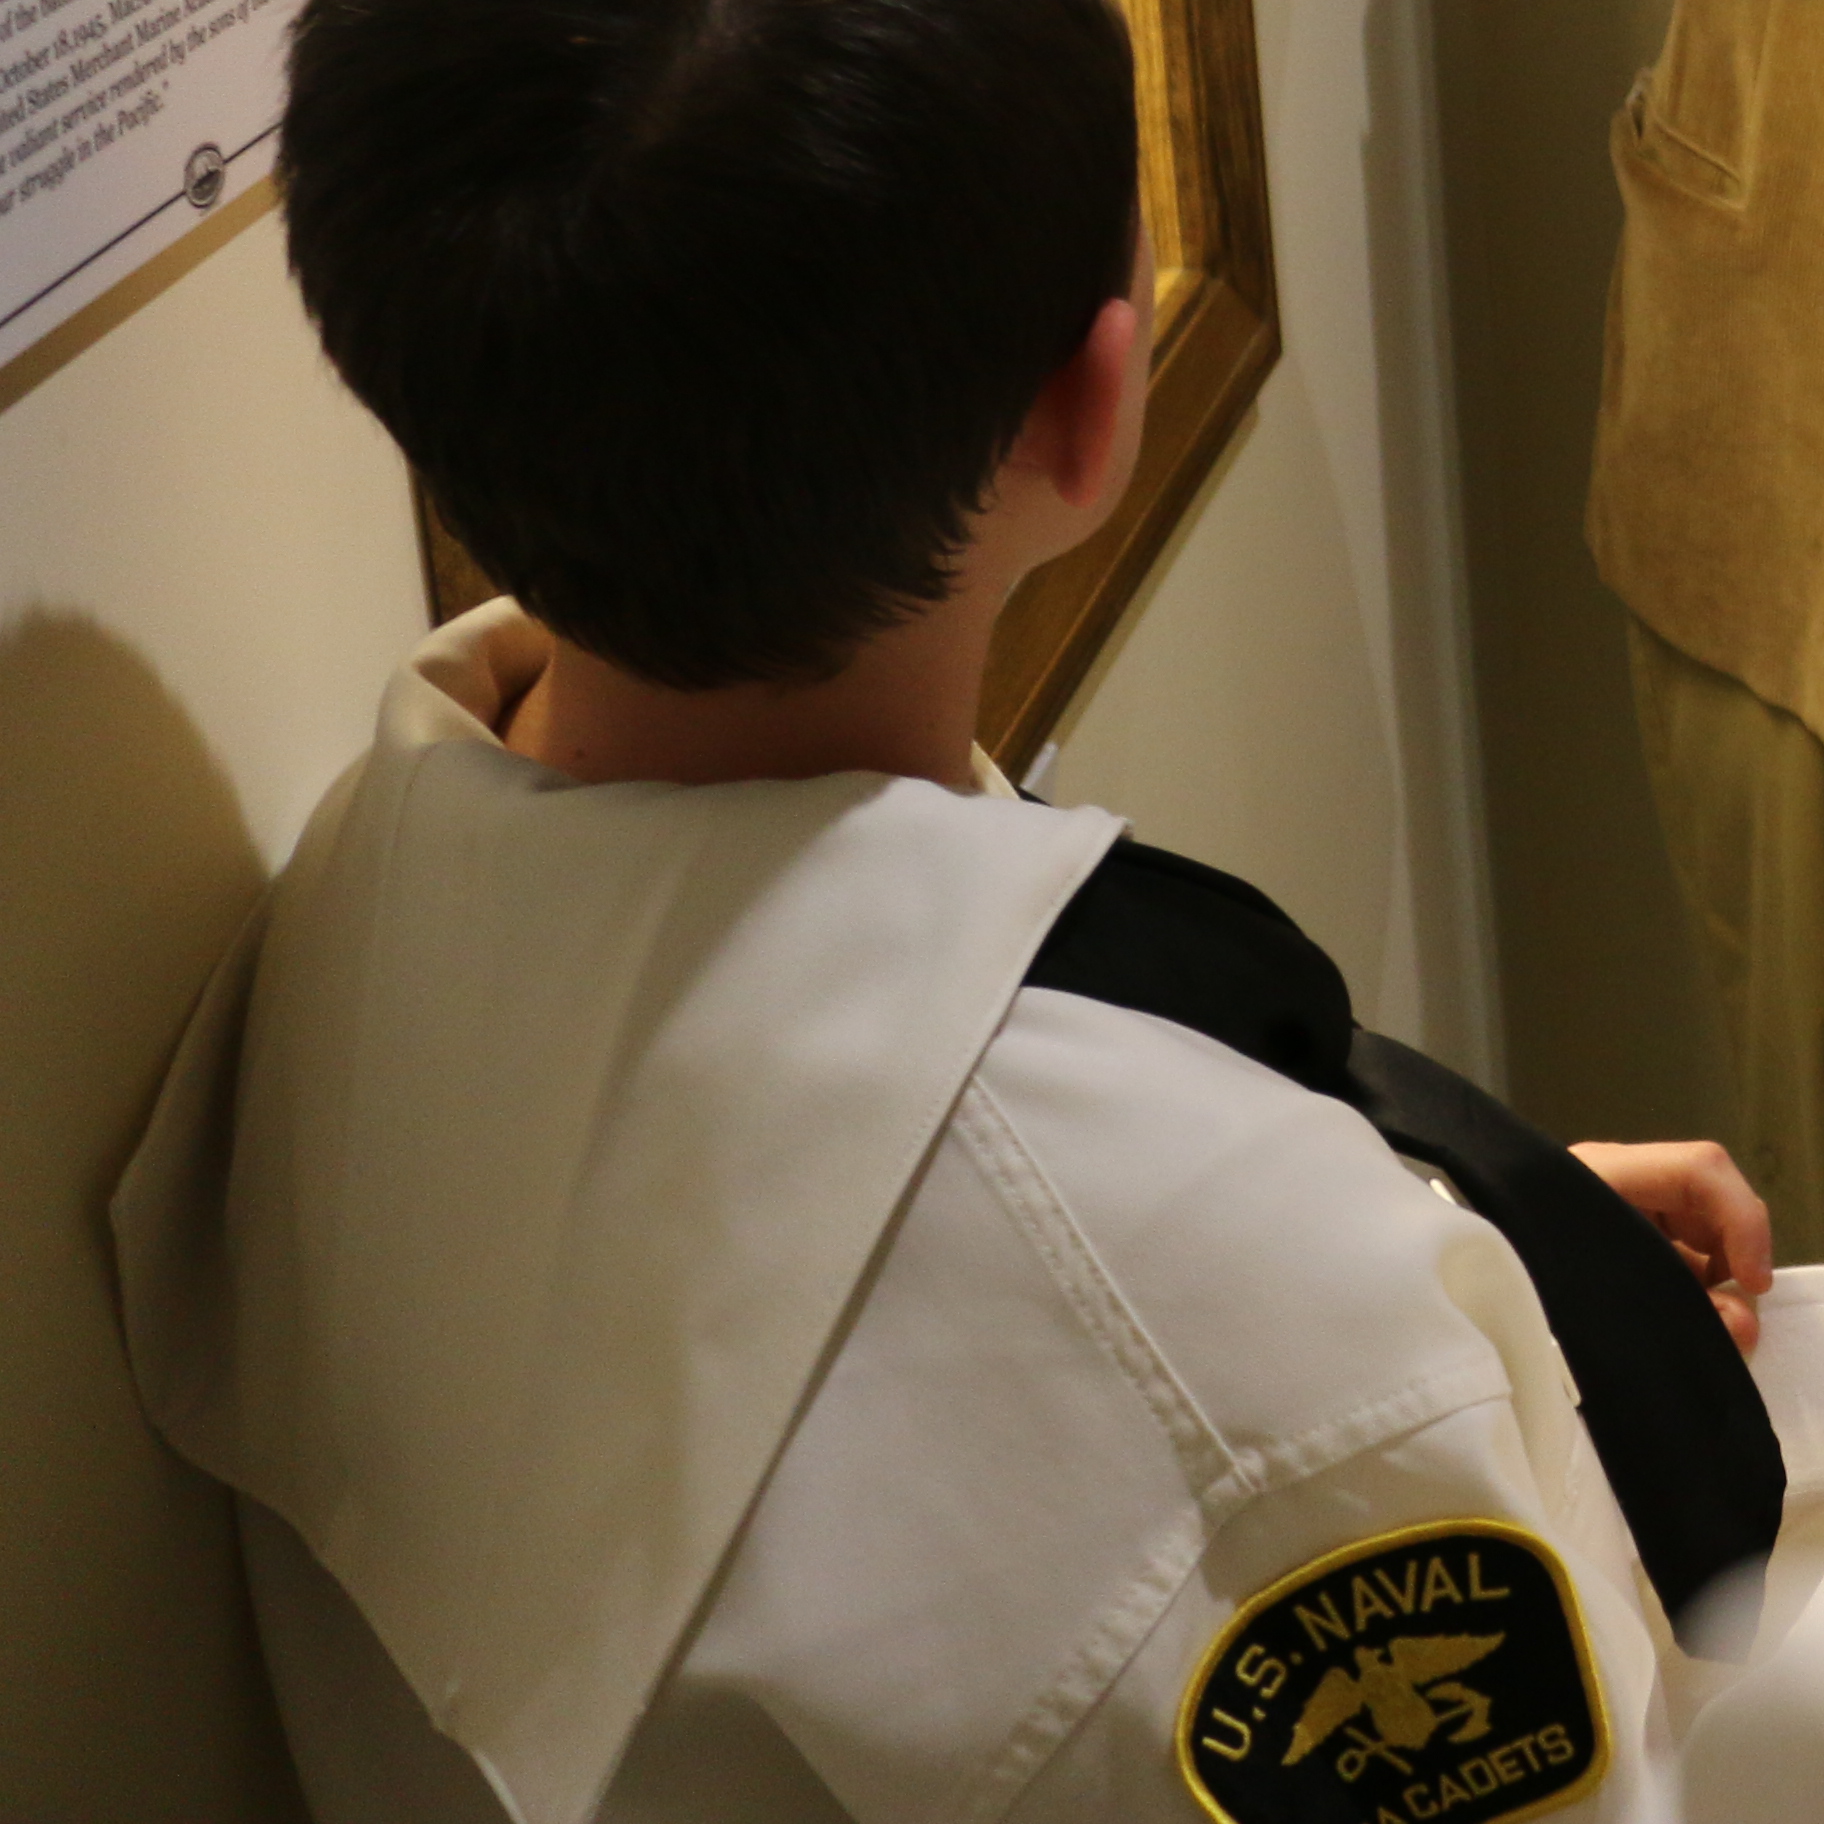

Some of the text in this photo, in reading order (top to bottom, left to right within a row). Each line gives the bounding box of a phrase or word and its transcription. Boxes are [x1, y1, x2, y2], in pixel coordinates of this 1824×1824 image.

[14, 4, 38, 32] the
[26, 76, 70, 115] States
[69, 32, 135, 88] Merchant
[134, 6, 181, 47] Marine
[8, 118, 59, 168] valiant
[61, 90, 107, 134] service
[108, 44, 168, 98] rendered
[186, 26, 206, 52] the
[208, 8, 236, 38] sons
[19, 146, 76, 203] struggle
[76, 139, 93, 162] in
[93, 123, 115, 152] the
[1202, 1552, 1511, 1764] U.S. NAVAL
[1402, 1722, 1576, 1821] CADETS
